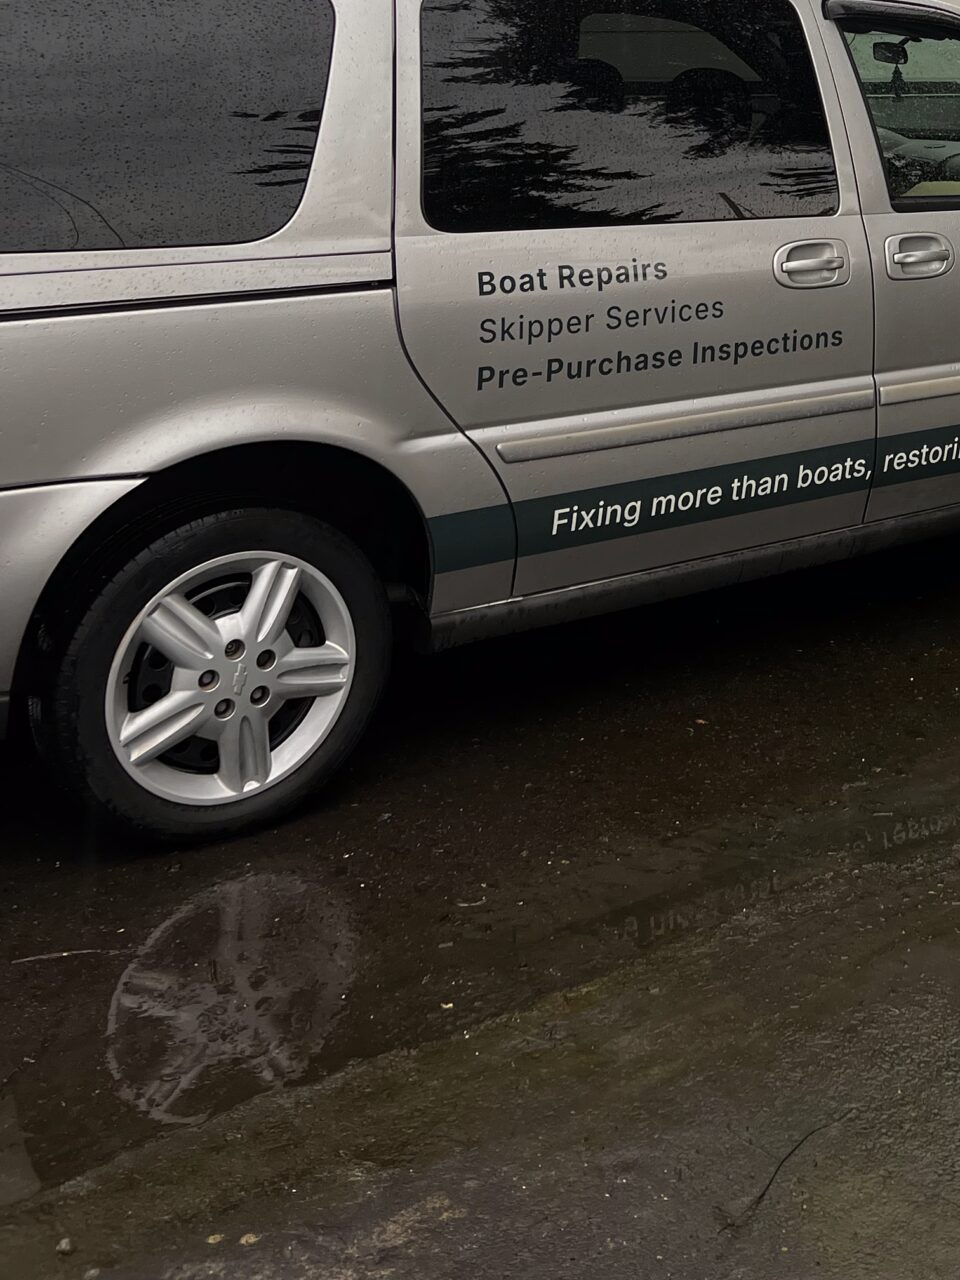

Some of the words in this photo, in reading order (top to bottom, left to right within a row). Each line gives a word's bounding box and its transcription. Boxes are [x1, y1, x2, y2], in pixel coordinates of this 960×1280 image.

[477, 267, 548, 296] Boat
[558, 258, 668, 291] Repairs
[479, 310, 595, 344] Skipper
[605, 298, 725, 330] Services
[476, 349, 683, 391] Pre-Purchase
[692, 328, 844, 365] Inspections
[551, 496, 642, 536] Fixing
[650, 483, 723, 517] more
[730, 469, 789, 501] than
[797, 457, 873, 489] boats,
